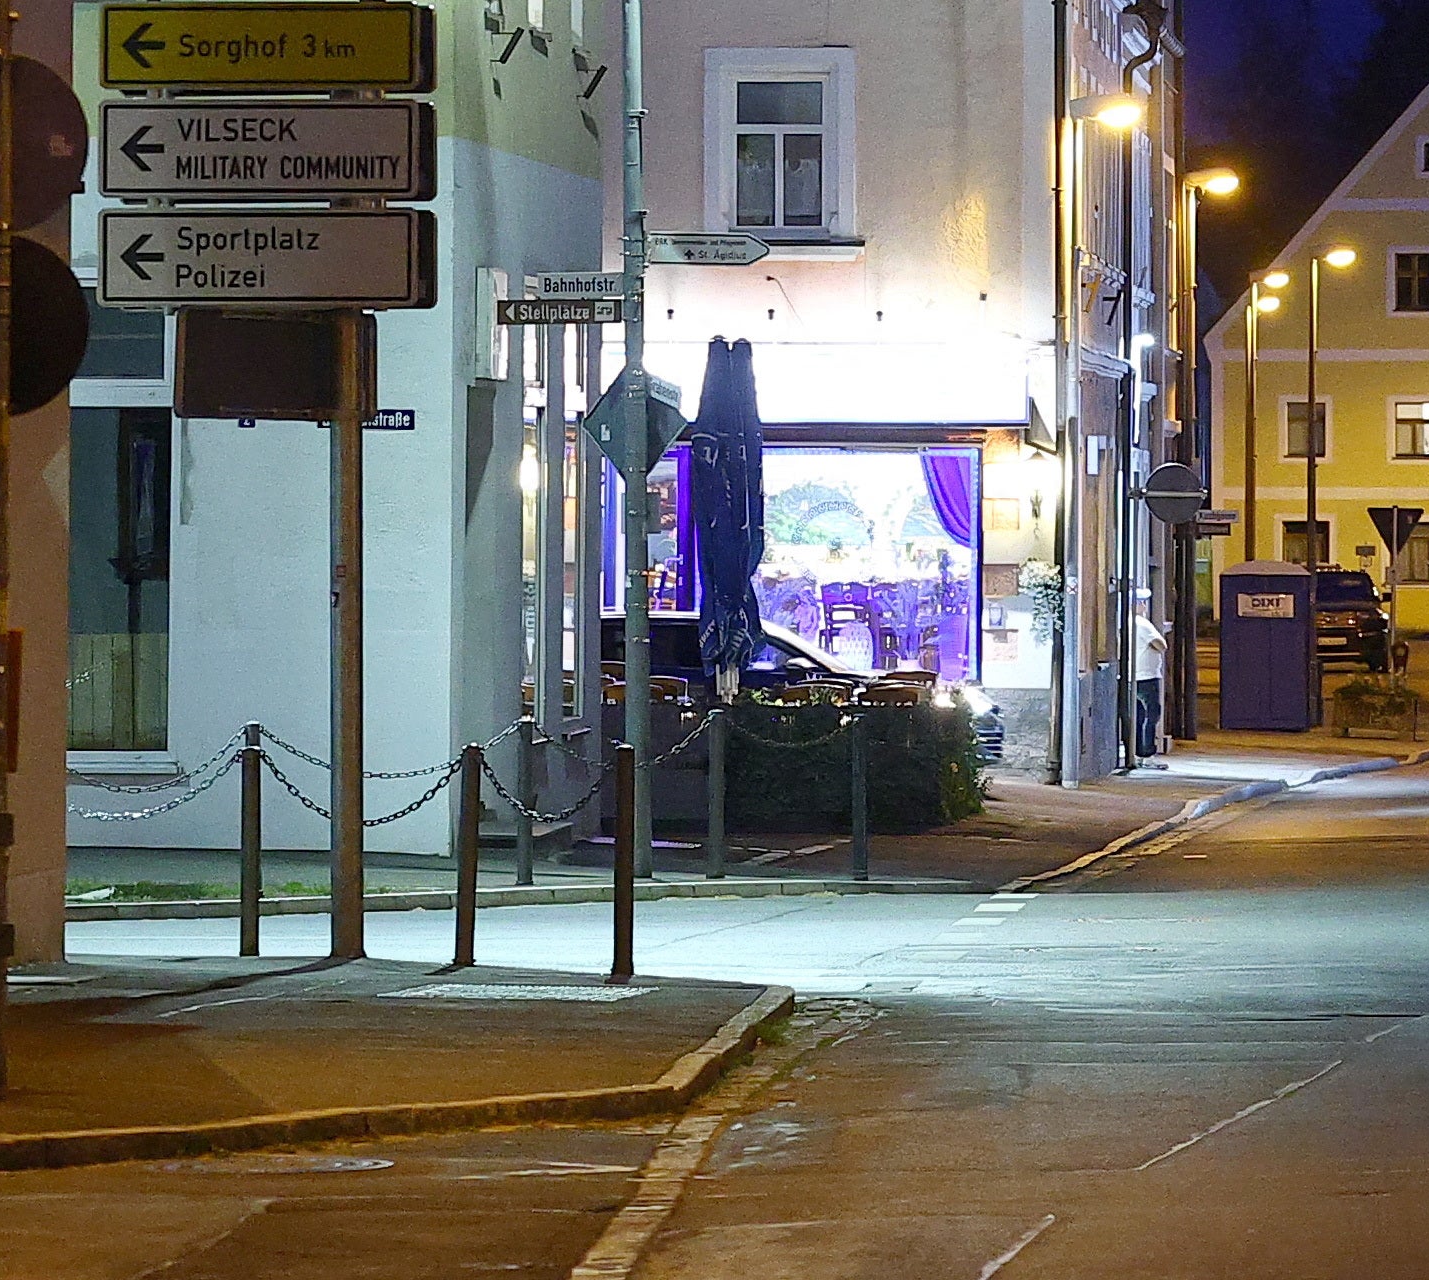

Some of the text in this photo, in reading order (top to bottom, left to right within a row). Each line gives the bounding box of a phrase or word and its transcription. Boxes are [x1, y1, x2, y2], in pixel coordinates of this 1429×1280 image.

[179, 34, 356, 64] Sorghof 3 km
[177, 118, 297, 142] VILSECK
[175, 155, 401, 180] MILITARY COMMUNITY
[177, 226, 320, 256] Sportplatz
[175, 265, 266, 288] Polizei
[544, 277, 617, 293] Bahnhofstr.
[520, 303, 590, 324] Stellplätze
[1252, 598, 1280, 608] DIXI
